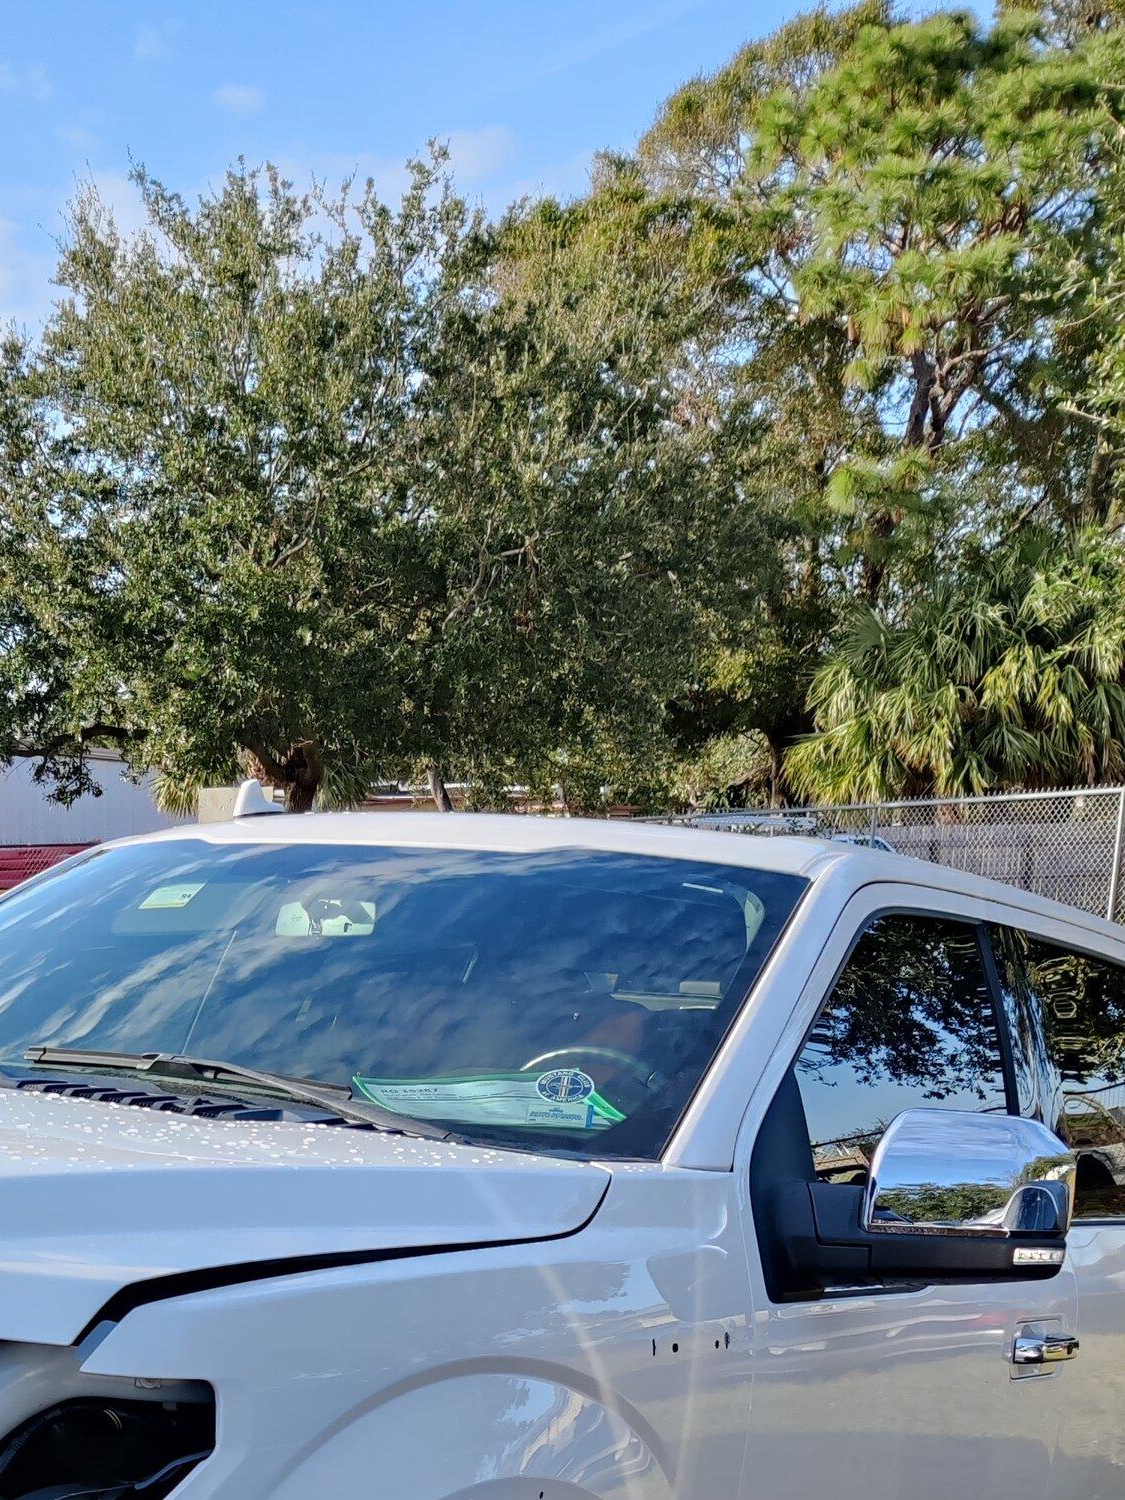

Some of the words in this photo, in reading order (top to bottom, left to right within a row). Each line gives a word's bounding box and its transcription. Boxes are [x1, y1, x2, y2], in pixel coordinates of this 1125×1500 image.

[540, 1071, 574, 1085] MUSTANG
[577, 1074, 591, 1088] CLUB
[550, 1094, 585, 1103] AMERICA
